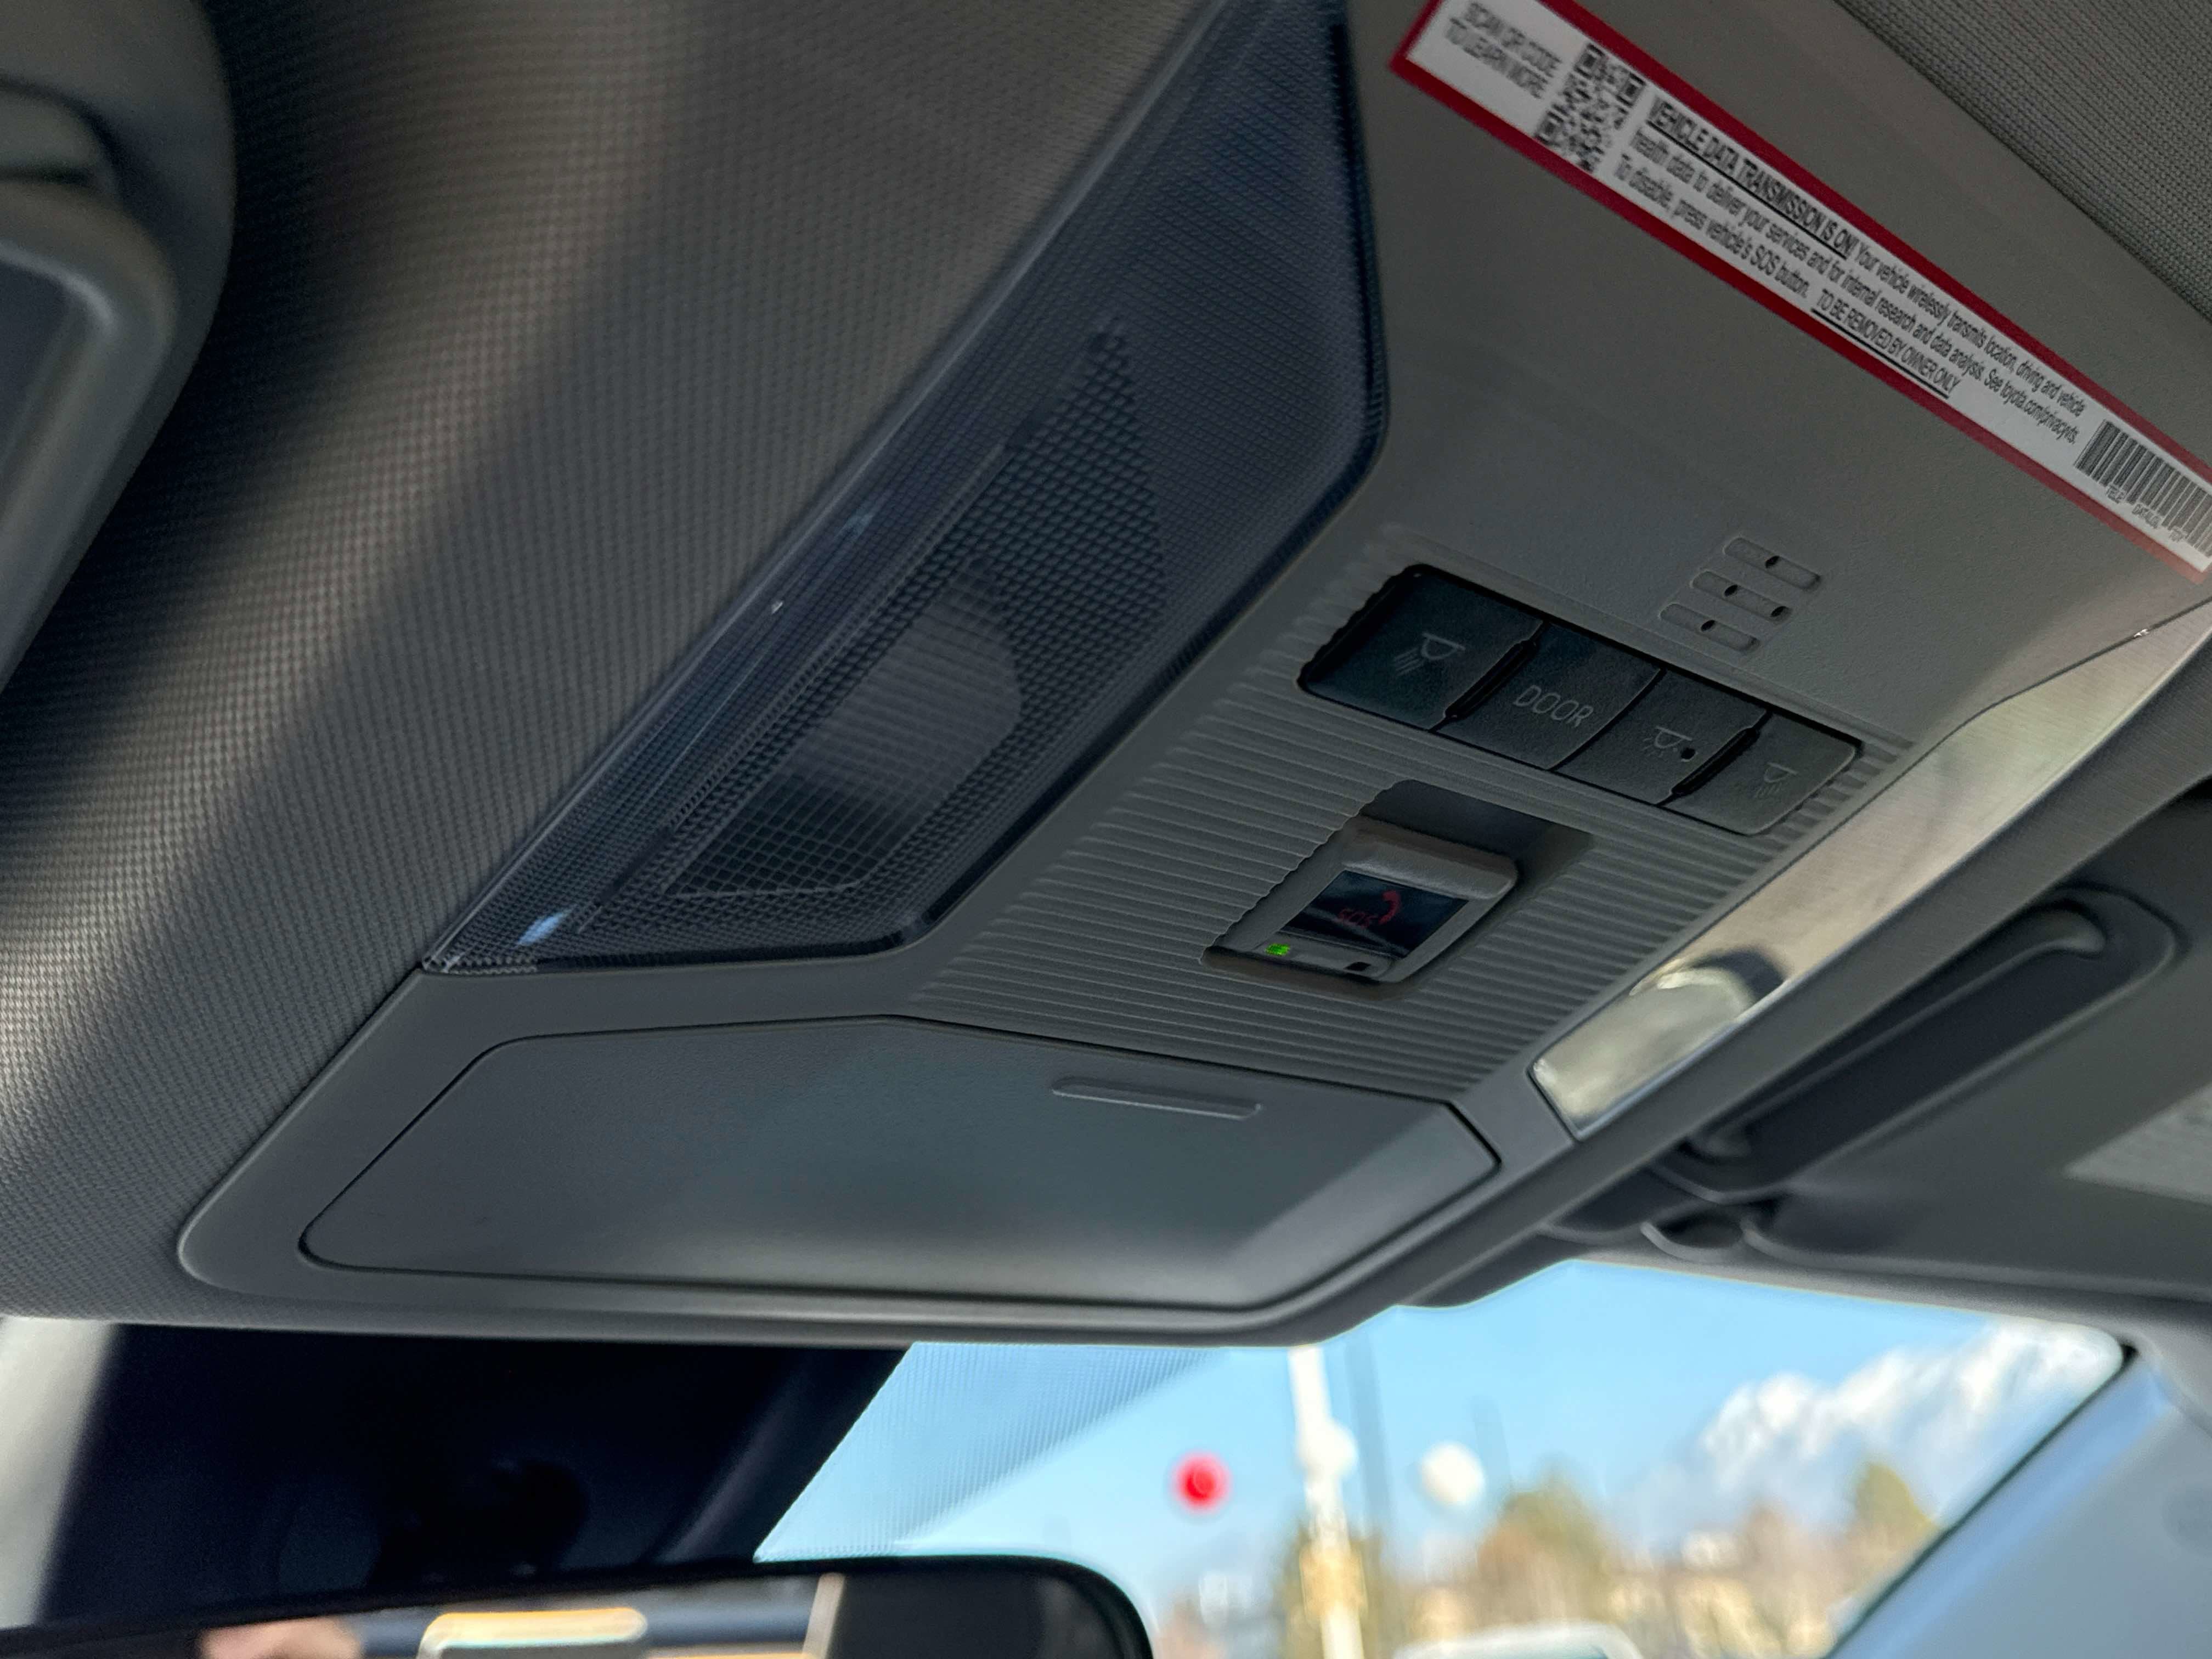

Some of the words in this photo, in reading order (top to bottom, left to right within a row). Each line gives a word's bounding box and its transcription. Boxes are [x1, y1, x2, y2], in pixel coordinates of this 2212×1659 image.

[1649, 97, 1709, 153] VEHICLE
[1702, 136, 1740, 176] DATA
[1735, 157, 1826, 234] TRANSMISSION
[1818, 219, 1838, 243] IS
[1854, 242, 1880, 272] Your
[1876, 262, 1910, 294] vehicle
[1907, 284, 1951, 326] wirelessly
[1947, 311, 1988, 349] transmits
[2016, 360, 2046, 392] driving
[2041, 380, 2062, 399] and
[2057, 391, 2086, 417] vehicle
[1665, 154, 1696, 184] data
[1692, 170, 1709, 193] to
[1738, 204, 1770, 233] your
[1765, 223, 1810, 261] services
[1807, 251, 1833, 275] and
[1827, 260, 1845, 283] for
[1841, 269, 1882, 307] internal
[1875, 297, 1916, 332] research
[1912, 323, 1937, 345] and
[1930, 332, 1953, 358] data
[1984, 369, 2004, 392] See
[1750, 244, 1781, 276] SOS
[1829, 298, 1849, 321] BE
[1843, 308, 1893, 349] REMOVED
[1887, 337, 1908, 357] BY
[1901, 346, 1938, 380] OWNER
[1933, 367, 1961, 394] ONLY
[1513, 685, 1594, 727] DOOR
[1338, 908, 1378, 929] SOS
